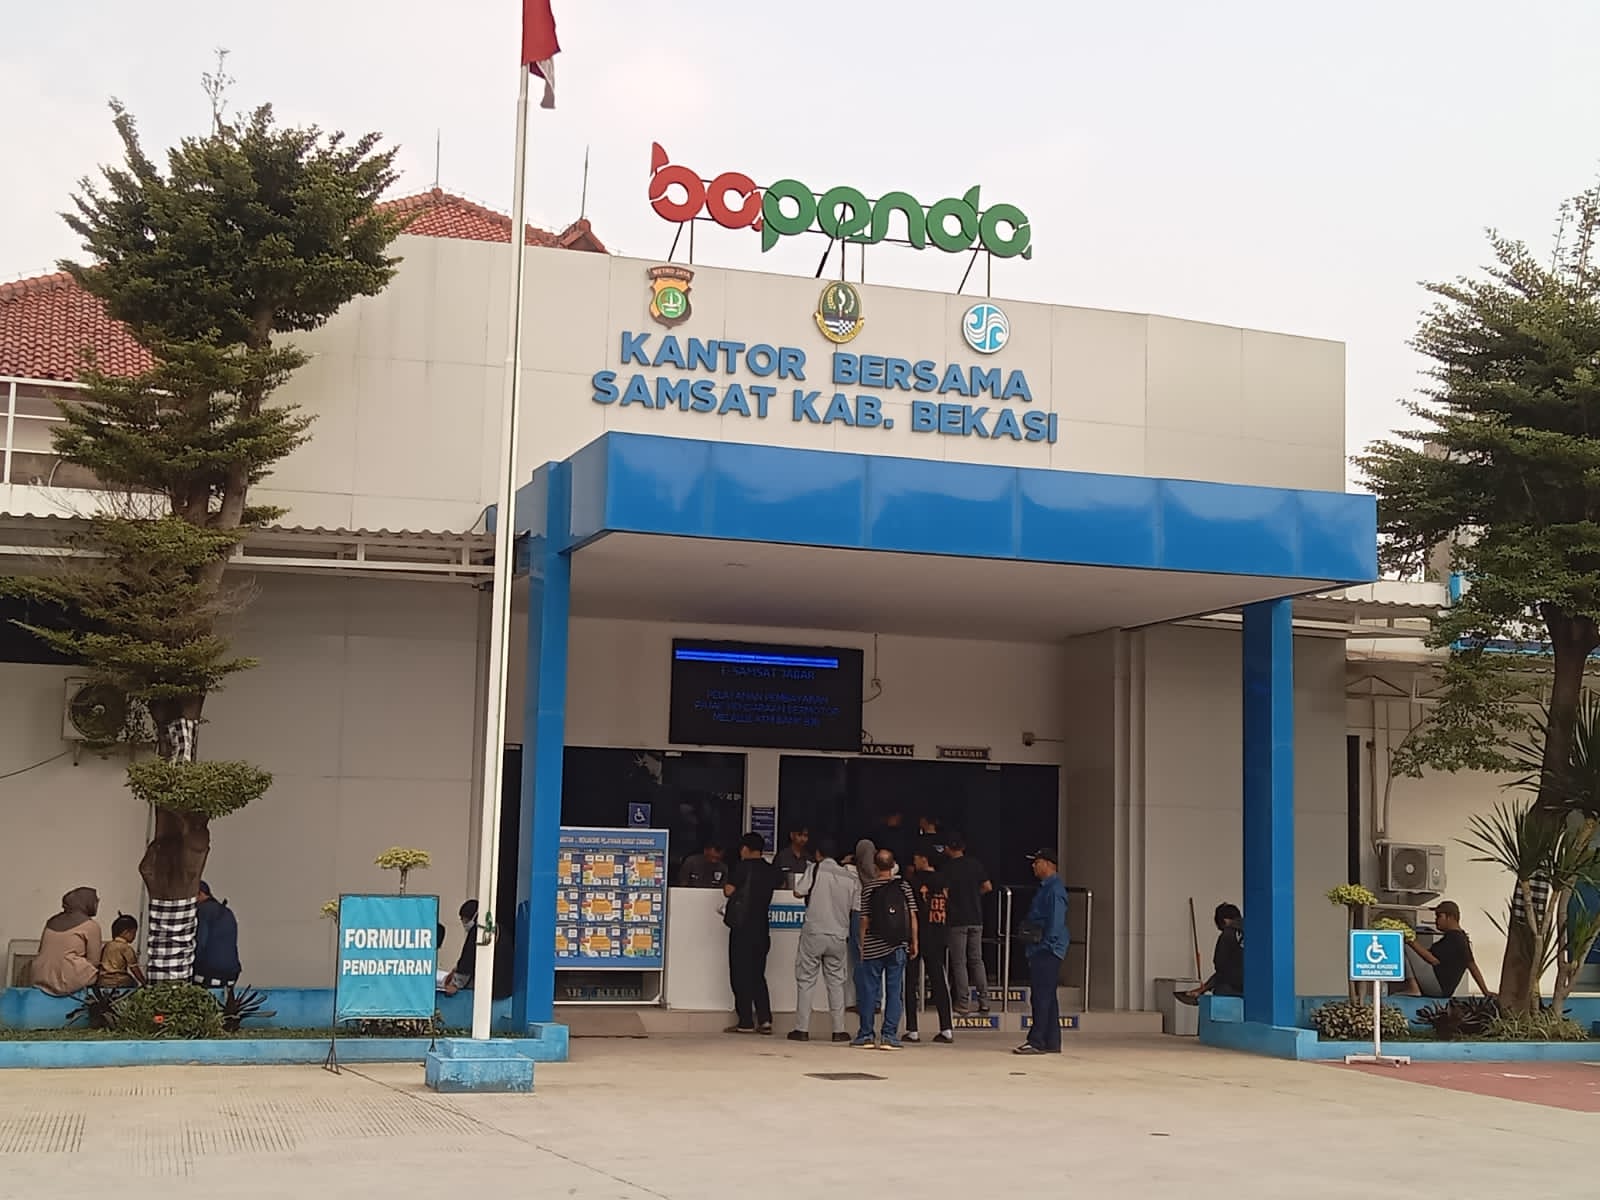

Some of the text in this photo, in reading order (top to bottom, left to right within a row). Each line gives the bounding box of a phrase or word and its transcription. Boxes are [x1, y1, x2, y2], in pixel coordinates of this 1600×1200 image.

[648, 141, 1032, 260] bapenda
[620, 330, 807, 380] KANTOR
[832, 351, 1033, 402] BERSAMA
[592, 370, 1058, 443] SAMSAT KAB. BEKASI
[344, 928, 432, 949] FORMULIR
[768, 911, 808, 923] ENDAFT
[342, 959, 432, 976] PENDAFTARAN
